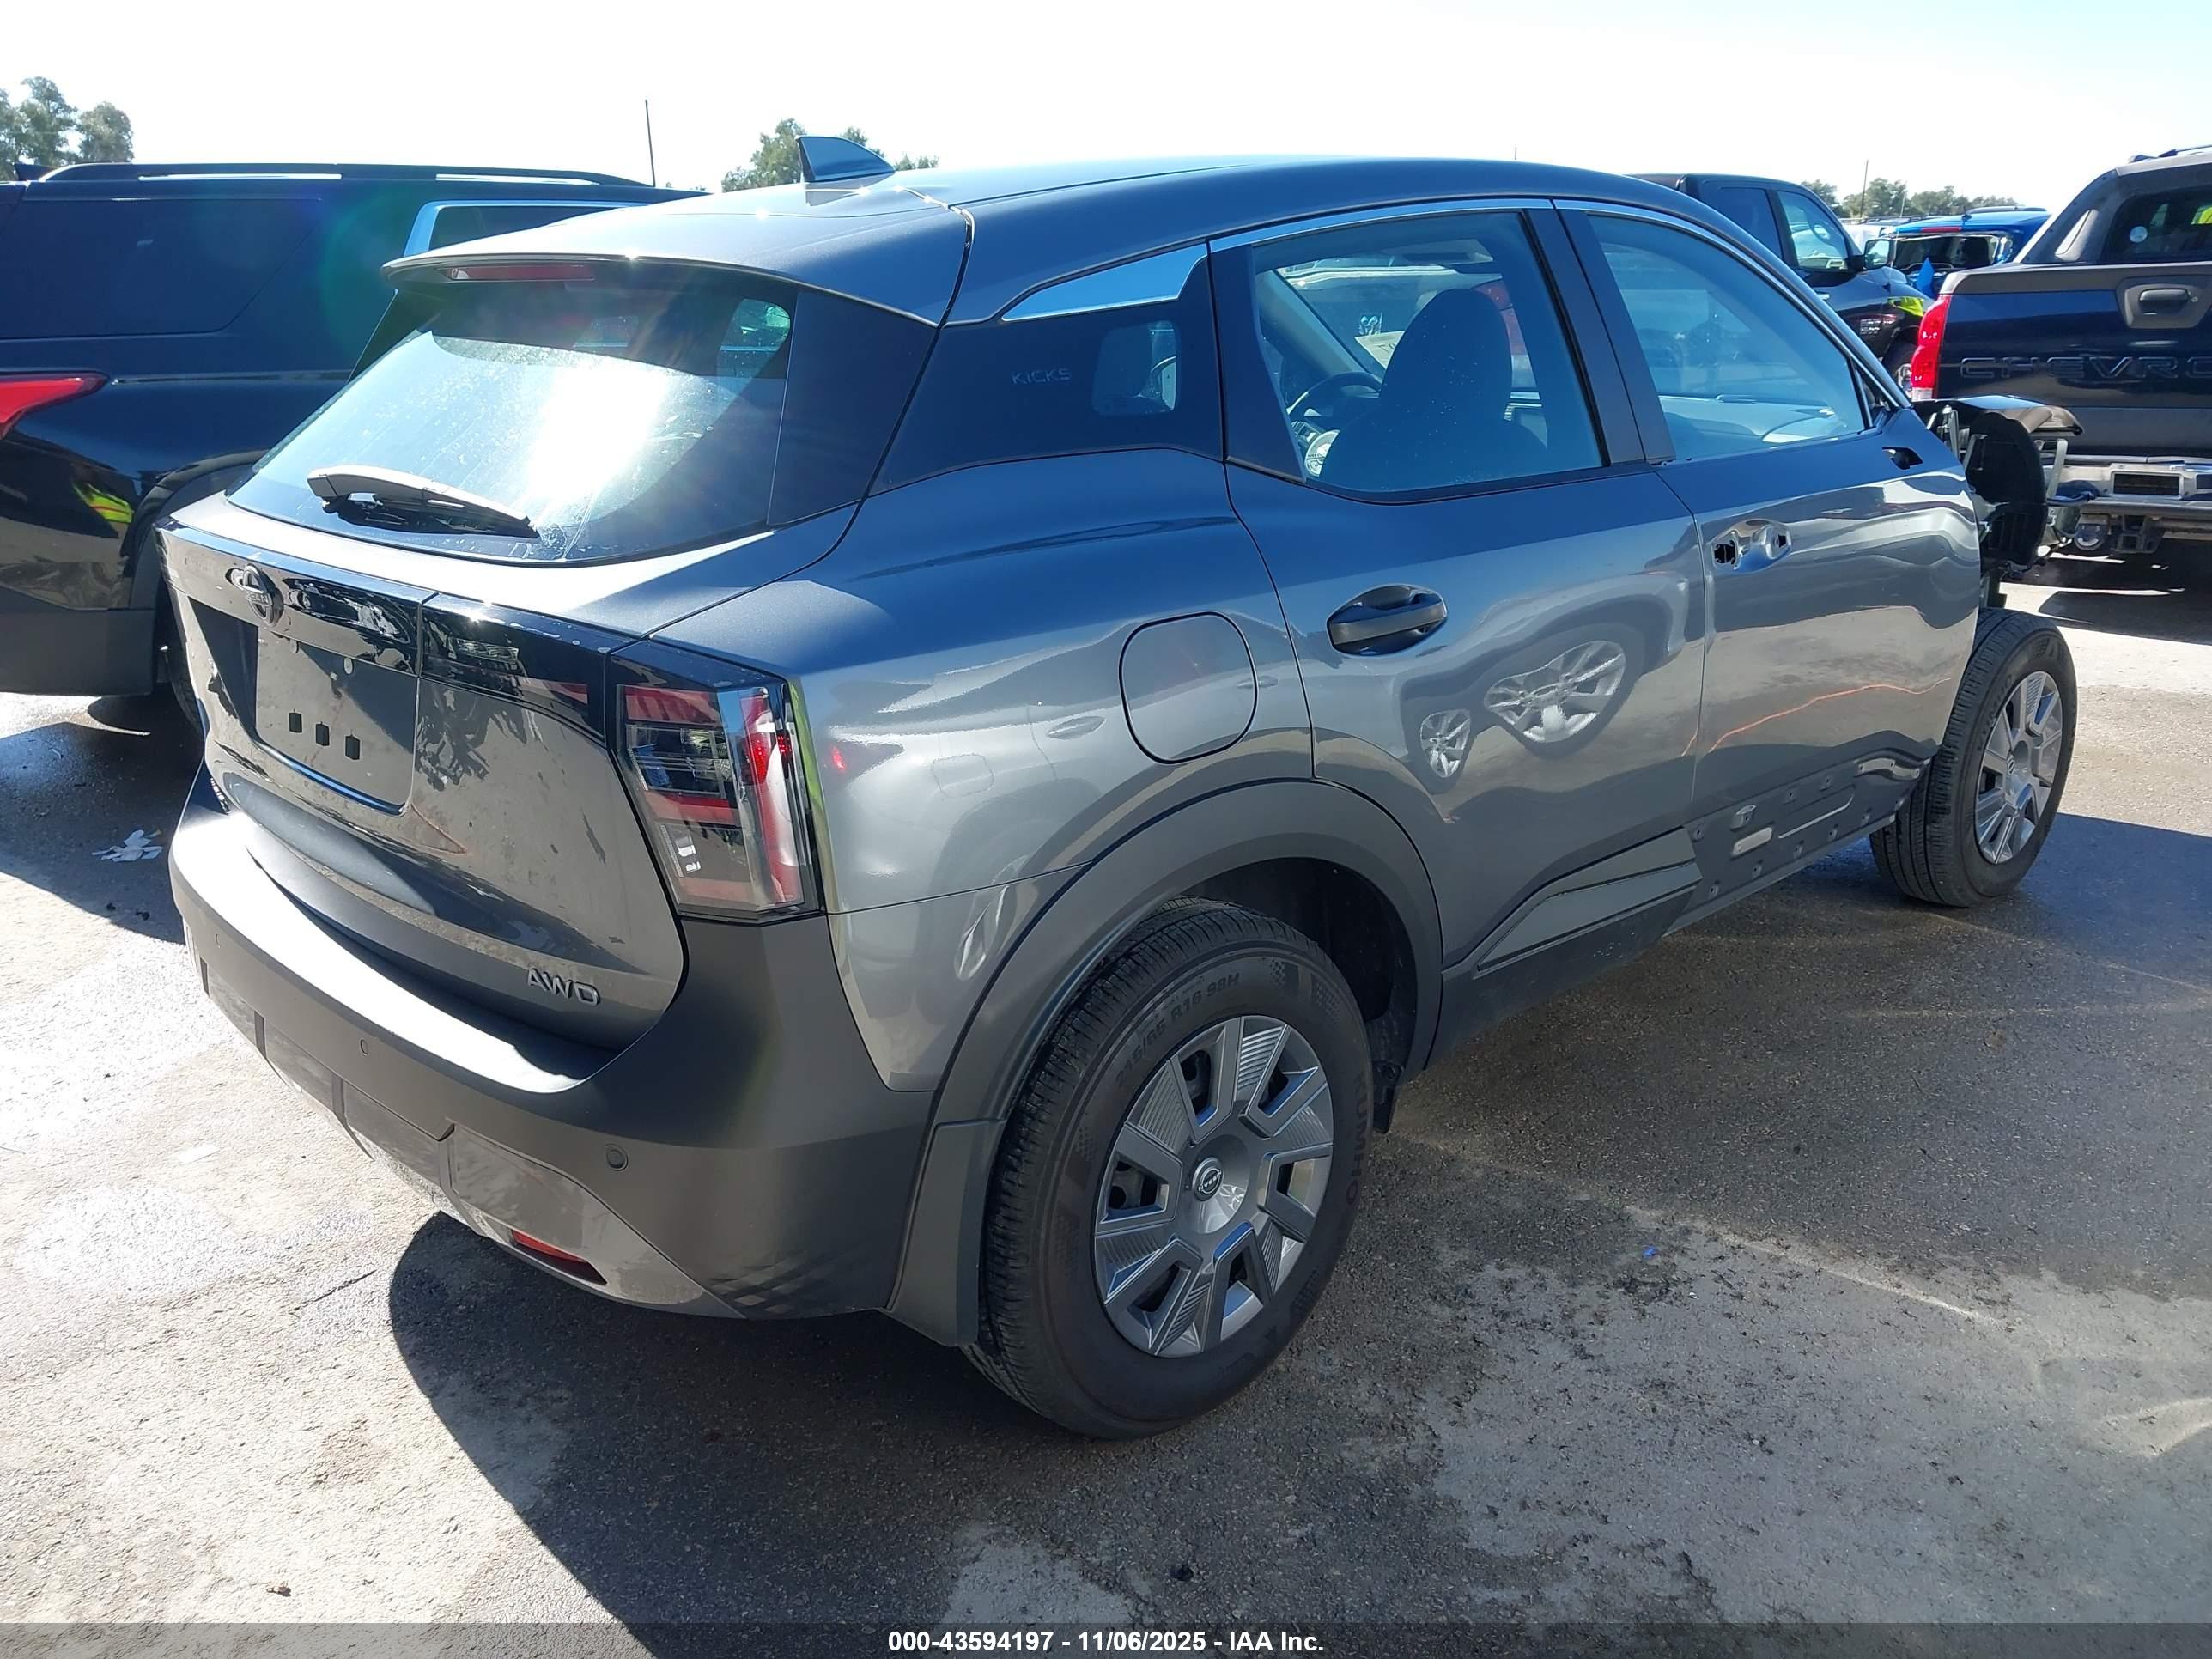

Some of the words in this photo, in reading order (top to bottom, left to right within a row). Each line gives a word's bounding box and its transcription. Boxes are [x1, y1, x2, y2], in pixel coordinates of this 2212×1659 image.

[1012, 368, 1072, 385] KICKS
[527, 968, 601, 1006] AWD
[1170, 990, 1203, 1022] R16
[1206, 972, 1240, 997] 98H
